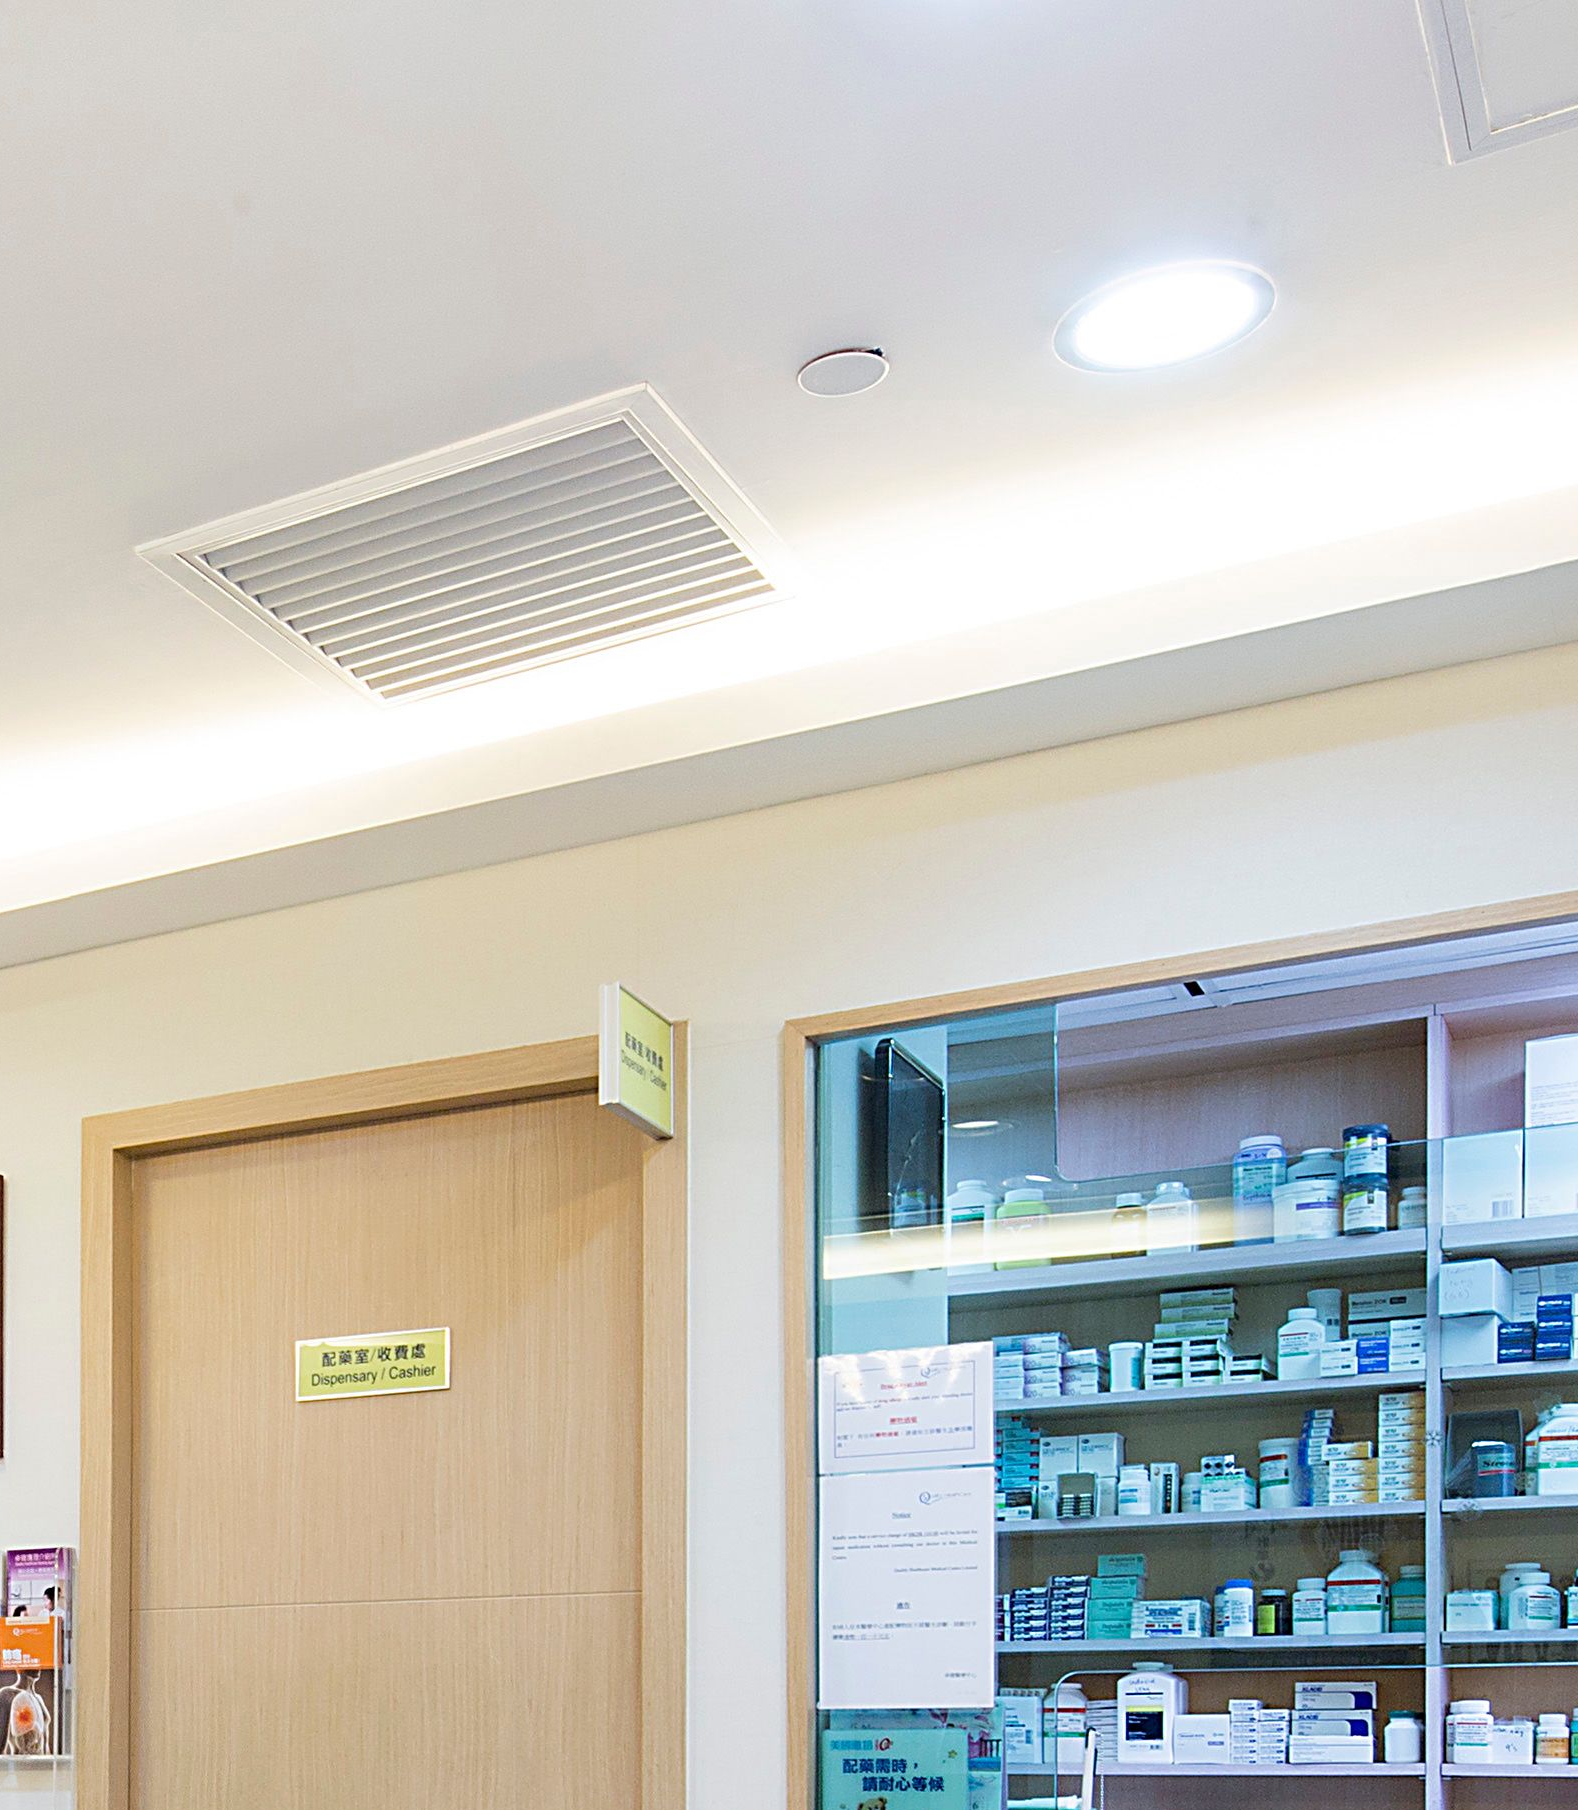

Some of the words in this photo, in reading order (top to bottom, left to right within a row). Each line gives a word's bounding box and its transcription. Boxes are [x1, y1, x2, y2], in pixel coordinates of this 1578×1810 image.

[311, 1368, 378, 1388] Dispensary
[388, 1362, 436, 1380] Cashier
[862, 1776, 945, 1792] 請耐心等候
